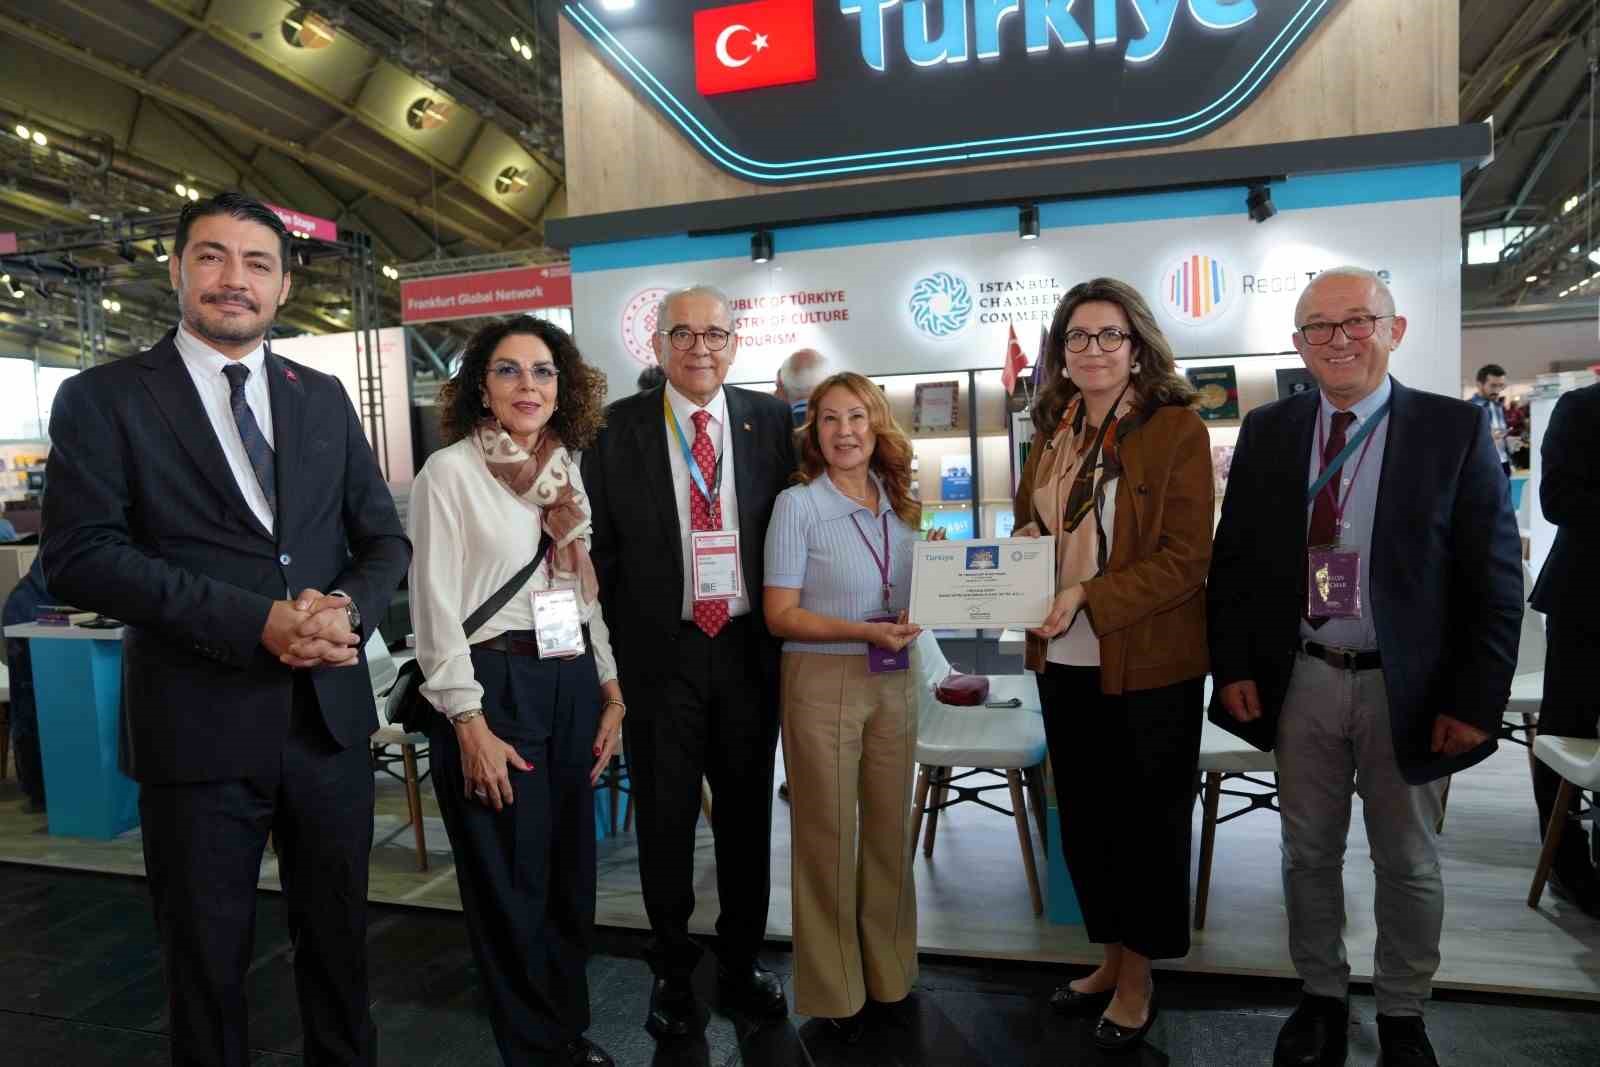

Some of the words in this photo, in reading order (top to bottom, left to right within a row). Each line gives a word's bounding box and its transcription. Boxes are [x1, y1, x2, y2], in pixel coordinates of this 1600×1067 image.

[980, 278, 1059, 293] ISTANBUL
[407, 295, 456, 311] Frankfurt
[458, 290, 494, 306] Global
[495, 285, 544, 303] Network
[728, 296, 767, 311] UBLIC
[979, 293, 1061, 309] CHAMBER
[791, 308, 849, 325] CULTURE
[979, 309, 1056, 324] COMMER
[738, 332, 797, 348] TOURISM
